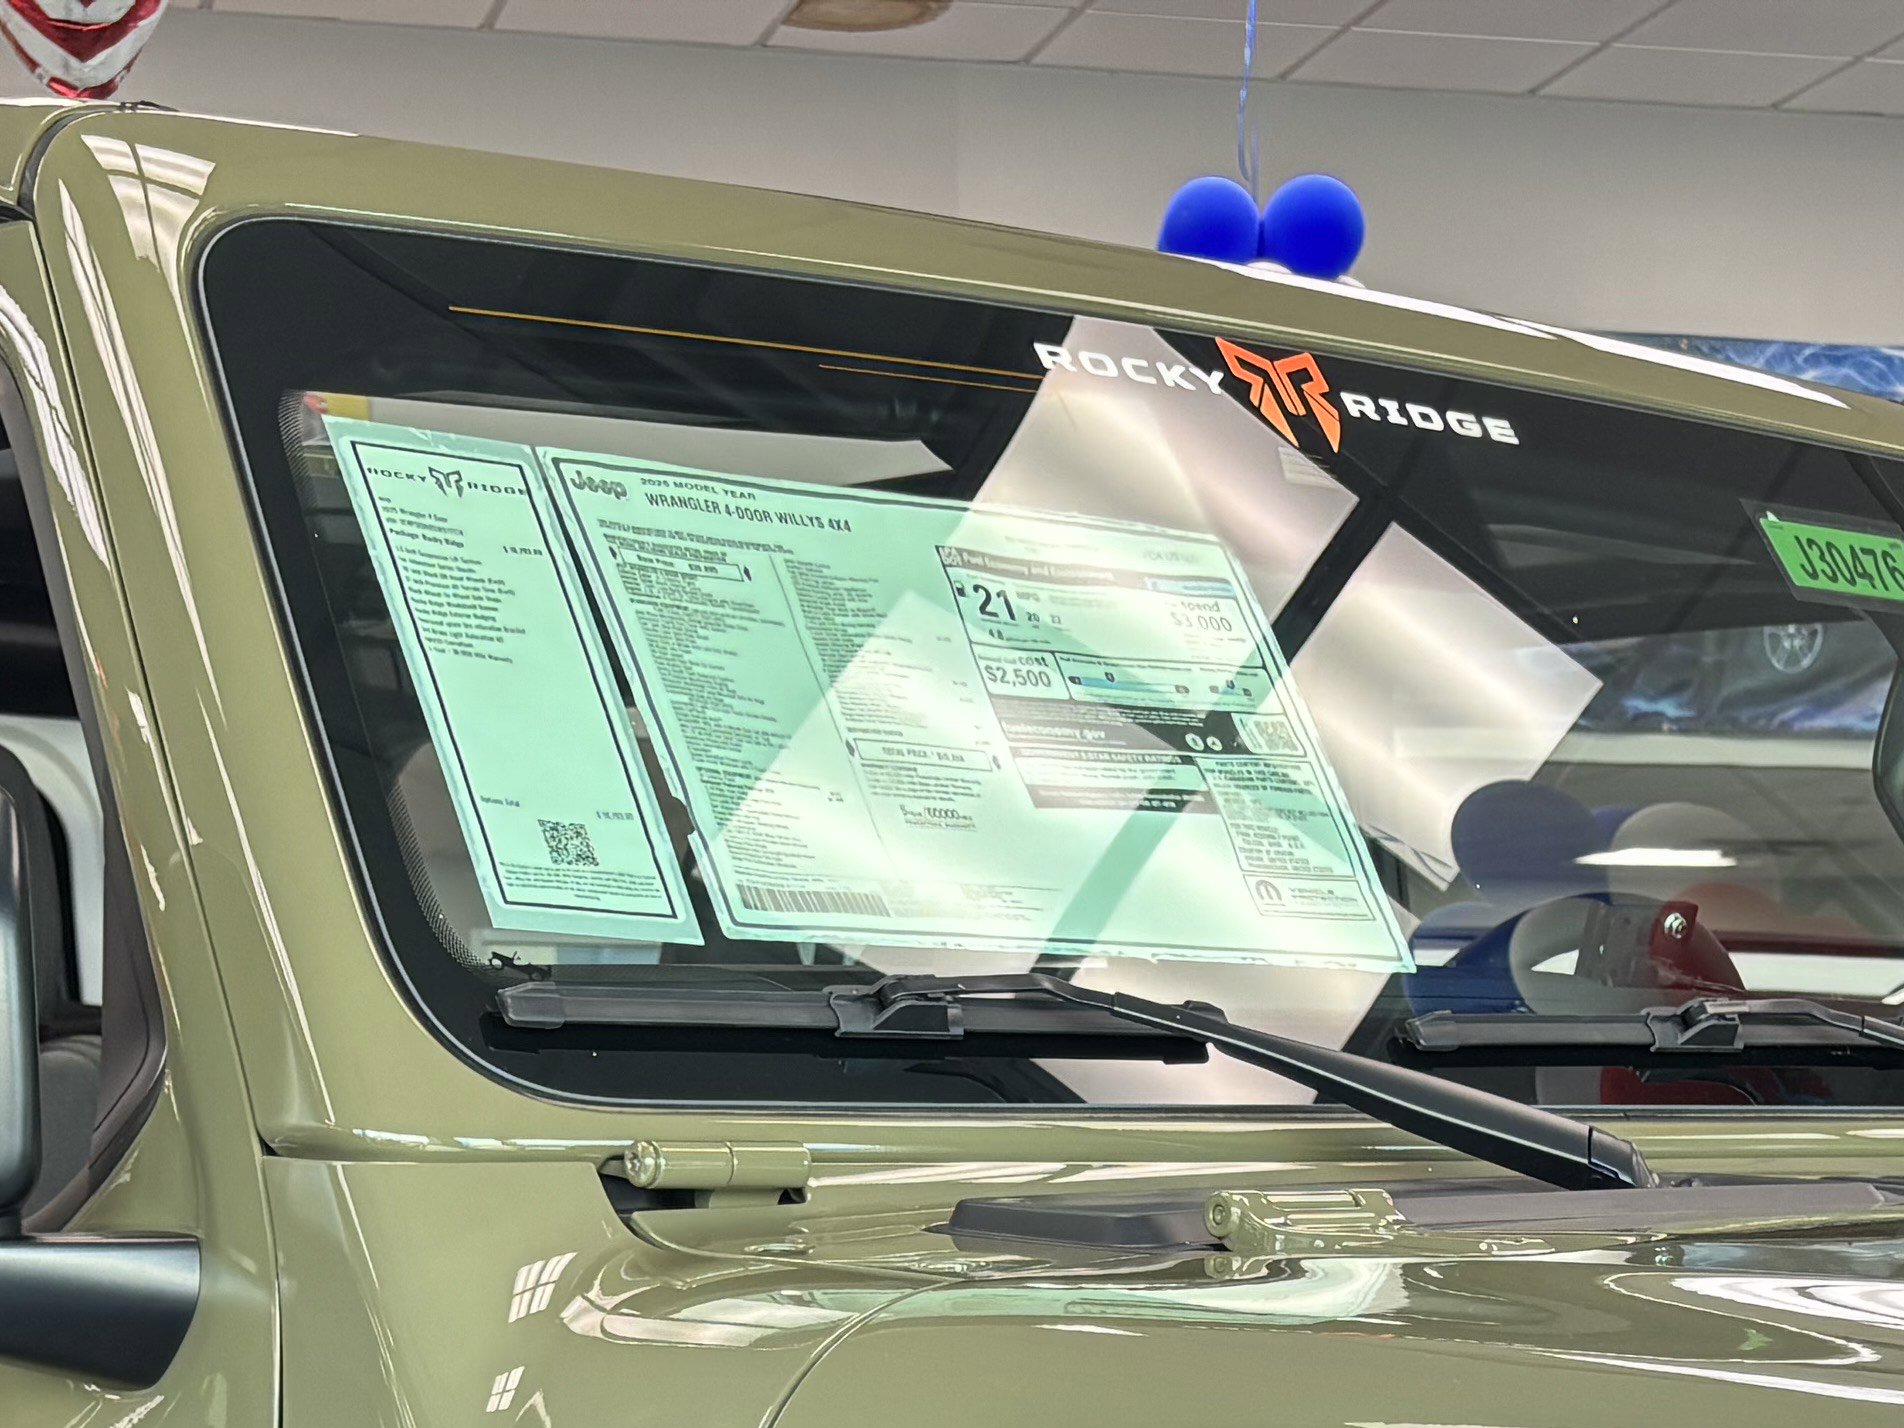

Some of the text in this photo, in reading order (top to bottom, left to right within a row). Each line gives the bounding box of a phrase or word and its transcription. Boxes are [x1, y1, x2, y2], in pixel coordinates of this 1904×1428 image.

[1033, 341, 1520, 446] ROCKY RIDGE
[570, 470, 628, 500] Jeep
[672, 481, 718, 494] MODEL
[722, 488, 756, 501] YEAR
[645, 492, 853, 533] WRANGLER 4-DOOR WILLYS 4X4
[972, 583, 1017, 623] 21
[984, 665, 1052, 689] $2,500
